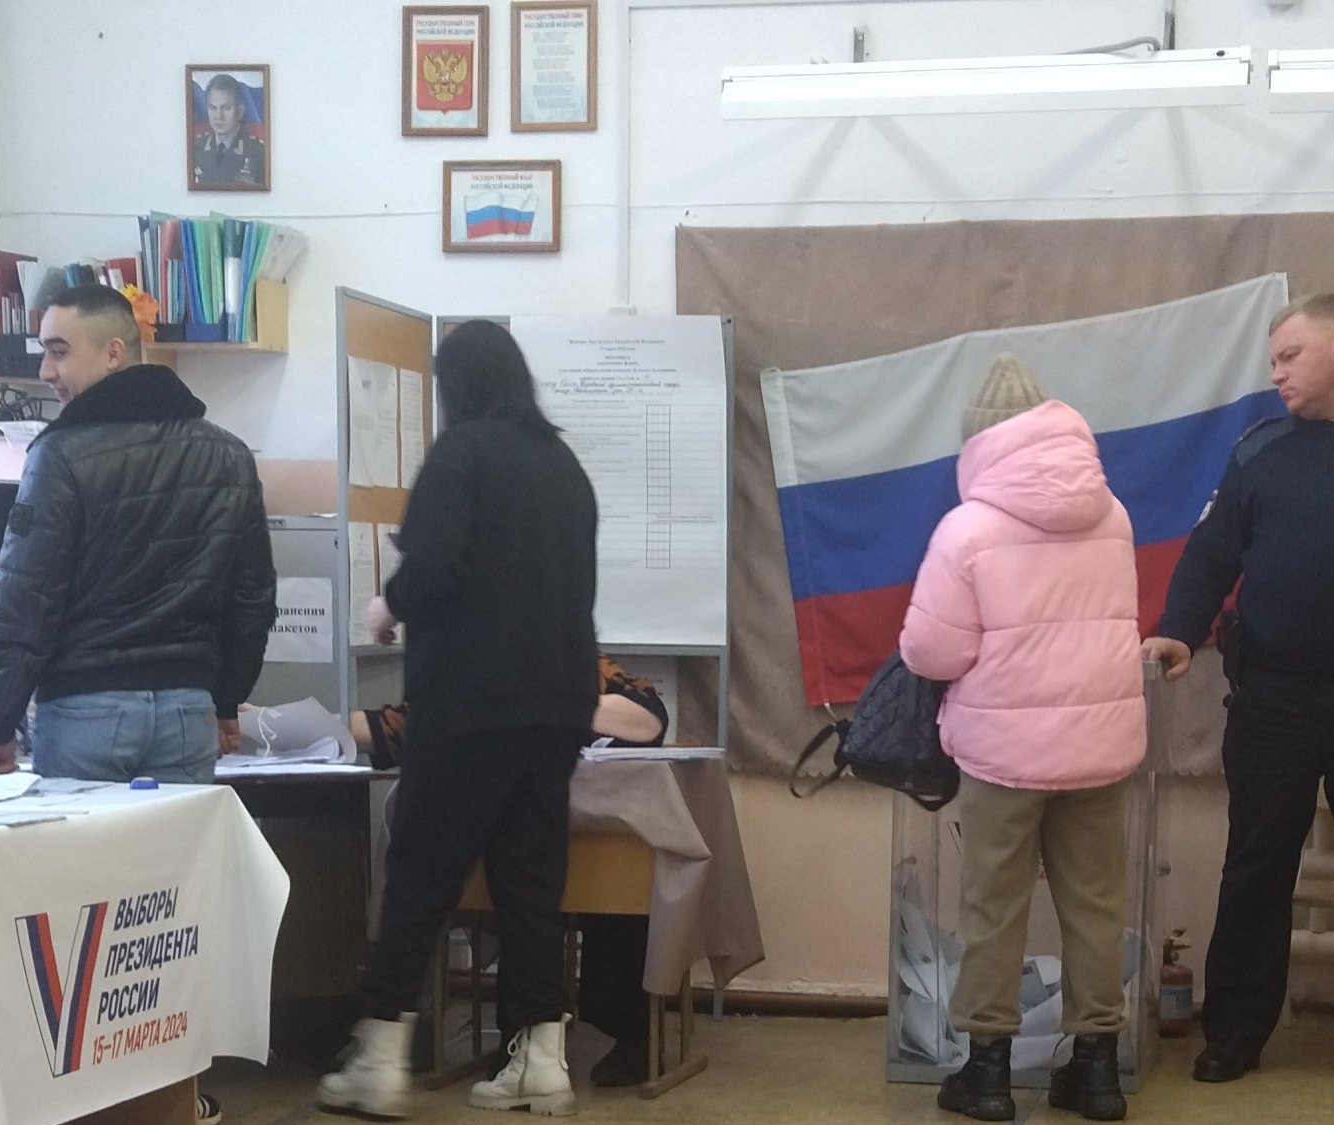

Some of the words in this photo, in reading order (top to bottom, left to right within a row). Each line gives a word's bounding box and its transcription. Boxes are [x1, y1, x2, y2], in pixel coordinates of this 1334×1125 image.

[276, 607, 325, 618] ранения
[113, 886, 179, 931] ВЫБОРЫ
[104, 925, 199, 978] ПРЕЗИДЕНТА
[97, 977, 160, 1025] РОССИИ
[124, 1018, 161, 1056] МАРТА
[162, 1010, 188, 1044] 2024
